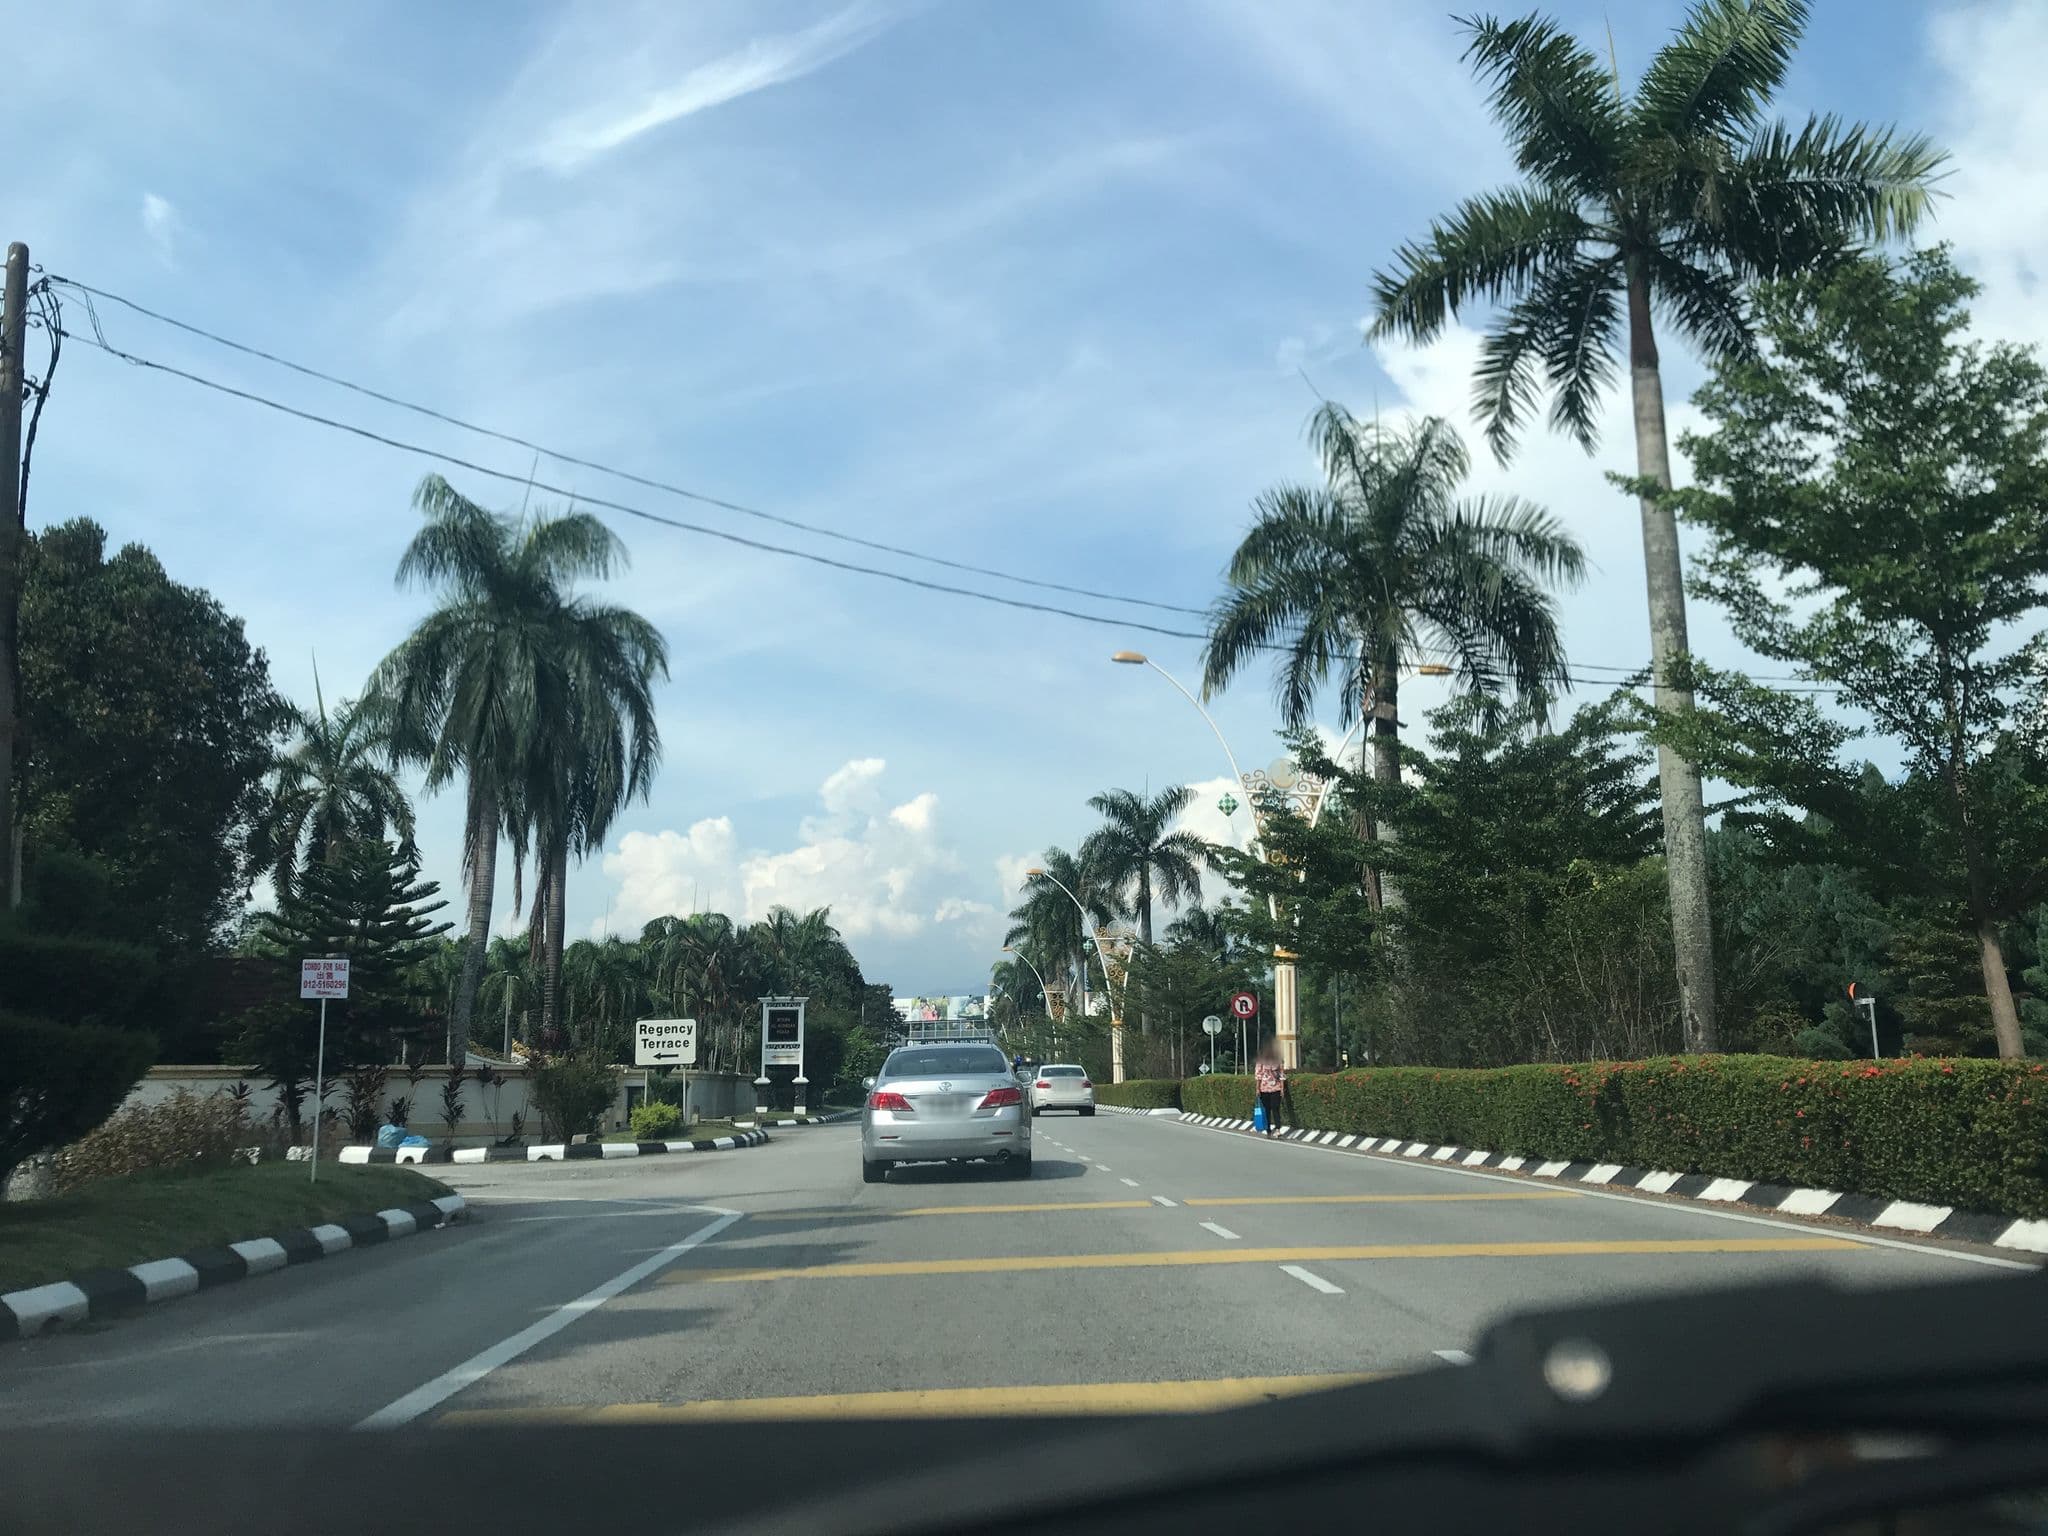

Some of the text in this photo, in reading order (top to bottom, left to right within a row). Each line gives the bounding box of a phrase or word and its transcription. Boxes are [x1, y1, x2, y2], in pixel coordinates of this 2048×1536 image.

[304, 962, 347, 971] CONDO FOR SALE
[639, 1024, 693, 1036] Regency
[641, 1038, 690, 1049] Terrace
